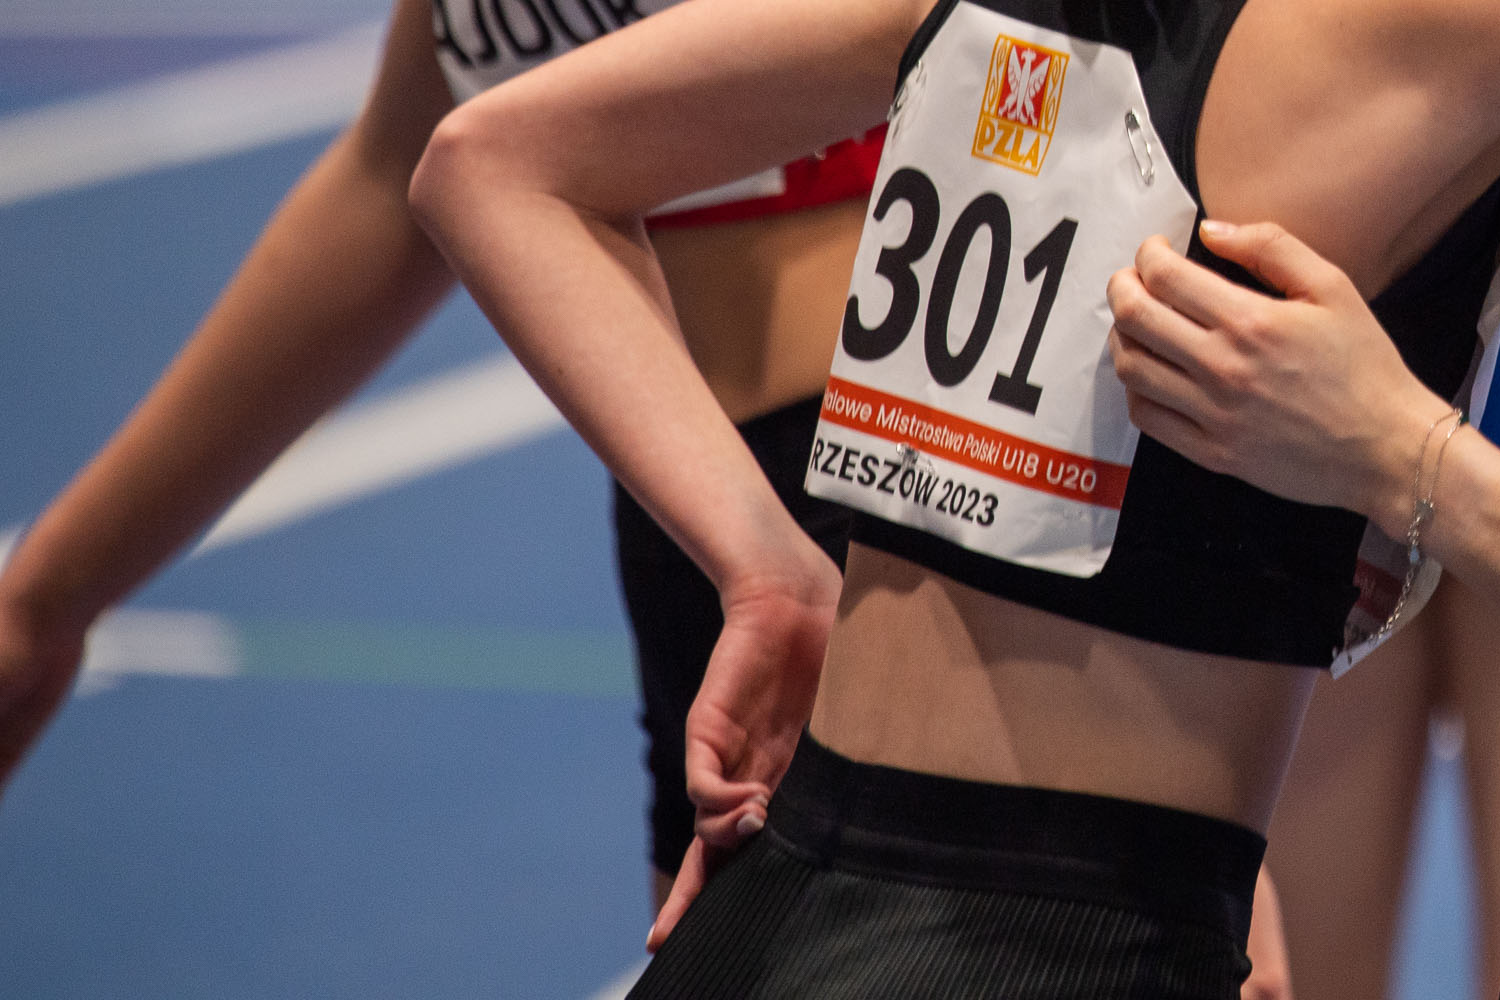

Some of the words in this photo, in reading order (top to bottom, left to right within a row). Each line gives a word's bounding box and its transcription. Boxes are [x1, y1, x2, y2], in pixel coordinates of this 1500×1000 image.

[976, 118, 1042, 169] PZLA
[841, 166, 1079, 417] 301
[824, 386, 873, 424] alowe
[876, 402, 964, 453] Mistrzostwa
[963, 432, 1003, 467] Polski
[1002, 446, 1040, 479] U18
[1045, 459, 1097, 494] U20
[936, 477, 999, 527] 2023
